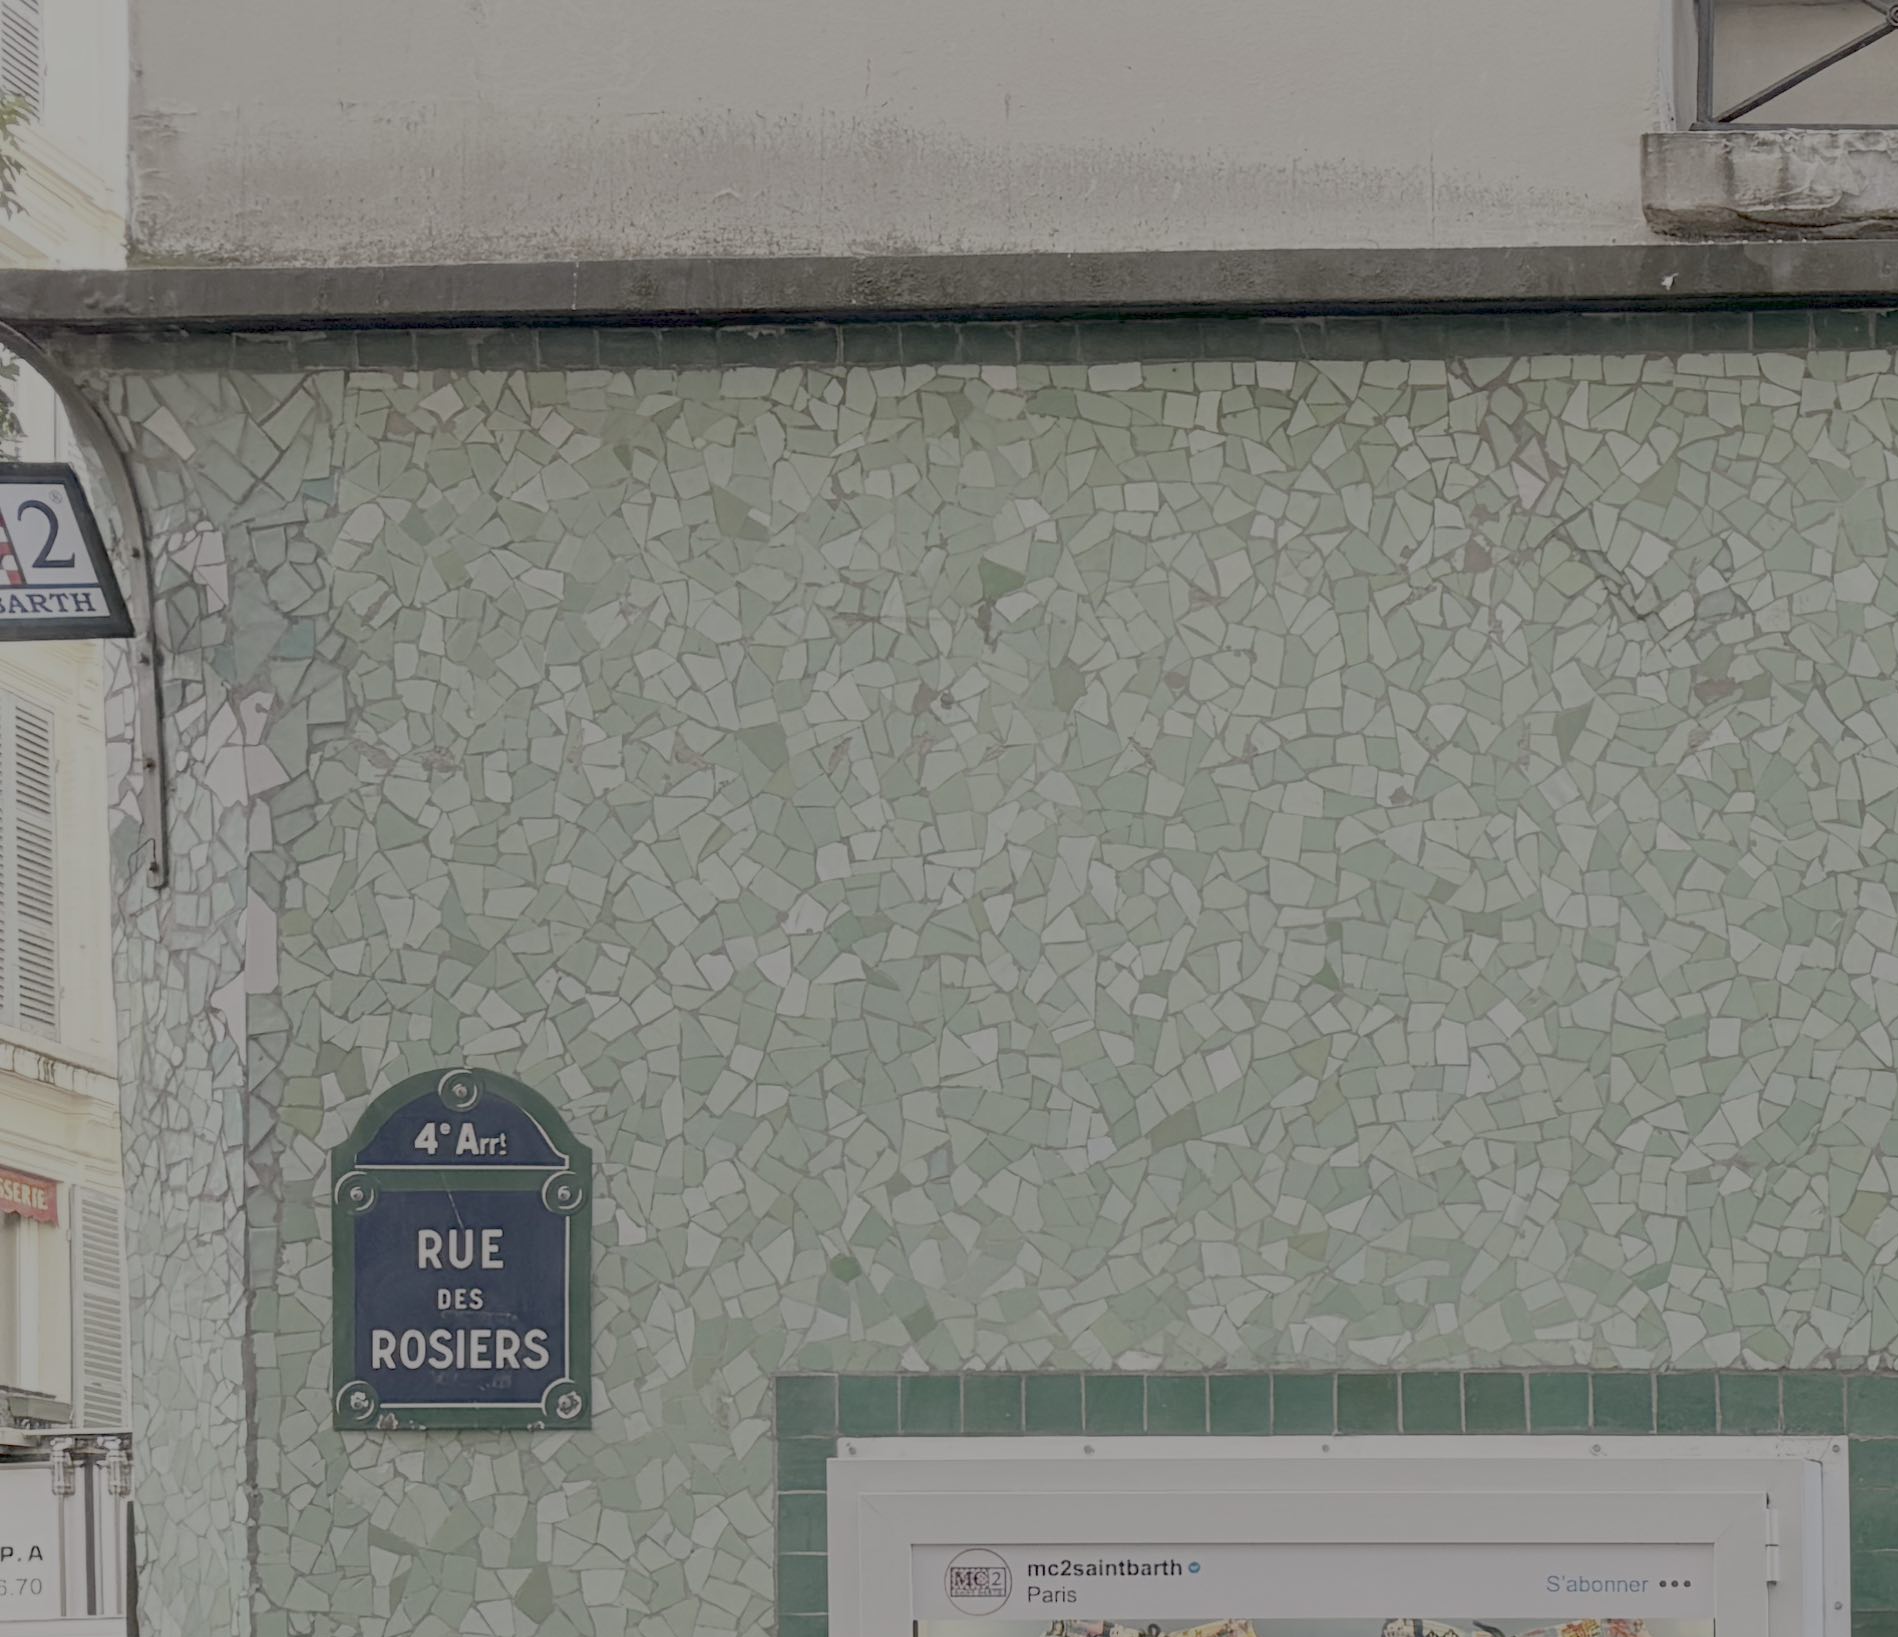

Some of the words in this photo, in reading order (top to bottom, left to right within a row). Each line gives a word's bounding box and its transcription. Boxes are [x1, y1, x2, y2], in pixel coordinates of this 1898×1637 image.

[0, 592, 97, 614] ARTH
[418, 1229, 504, 1269] RUE
[437, 1288, 484, 1311] DES
[371, 1329, 550, 1370] ROSIERS
[1027, 1559, 1183, 1577] mc2saintbarth
[1028, 1585, 1078, 1603] Paris
[1546, 1575, 1649, 1593] S'abonner
